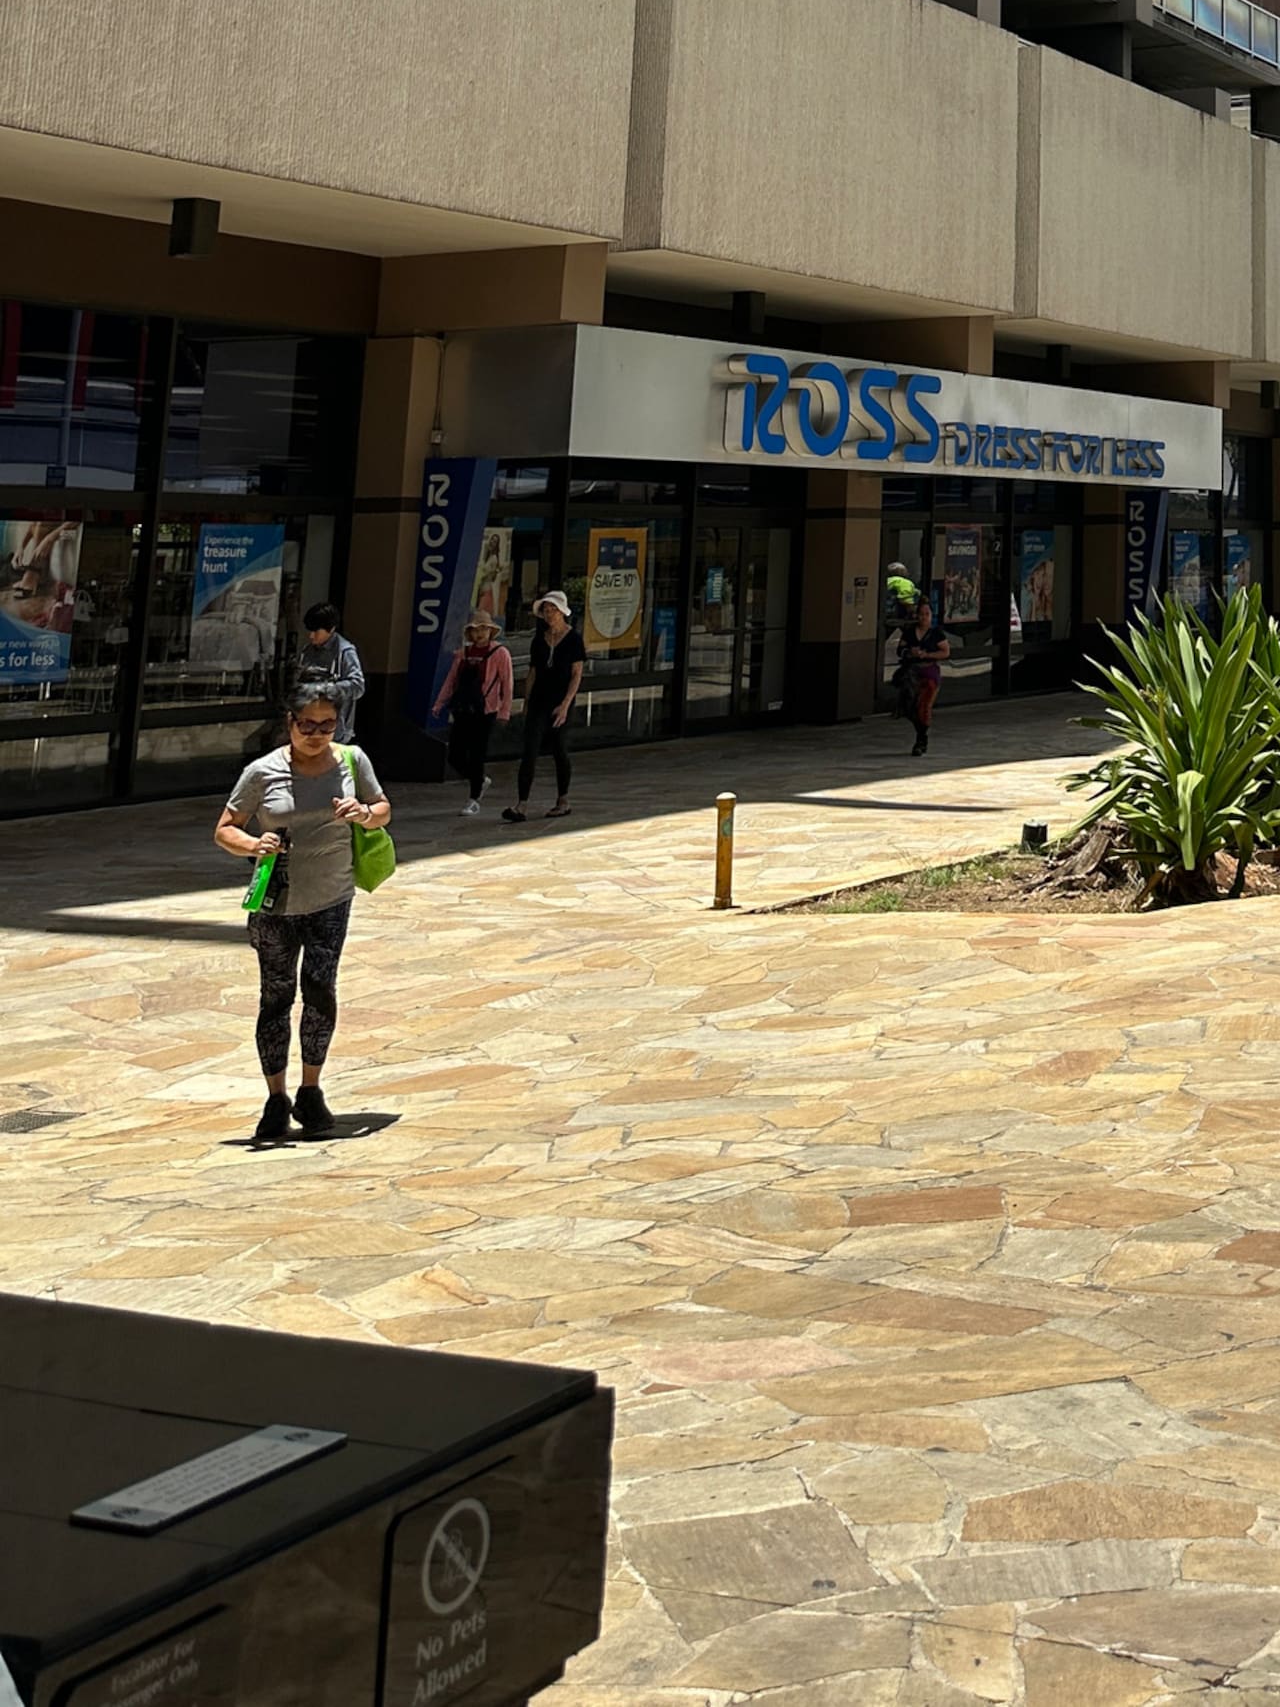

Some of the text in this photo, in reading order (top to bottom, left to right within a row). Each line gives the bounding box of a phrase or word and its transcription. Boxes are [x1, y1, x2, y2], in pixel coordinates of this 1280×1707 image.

[730, 353, 1165, 478] ROSS DRESS FOR LESS
[202, 559, 228, 573] hunt
[203, 546, 247, 558] treasure
[416, 473, 452, 634] ROSS
[1127, 500, 1147, 600] ROSS
[594, 574, 622, 588] SAVE
[8, 652, 28, 667] for
[31, 651, 55, 666] less
[416, 1610, 487, 1669] No Pets
[411, 1637, 487, 1707] Allowed
